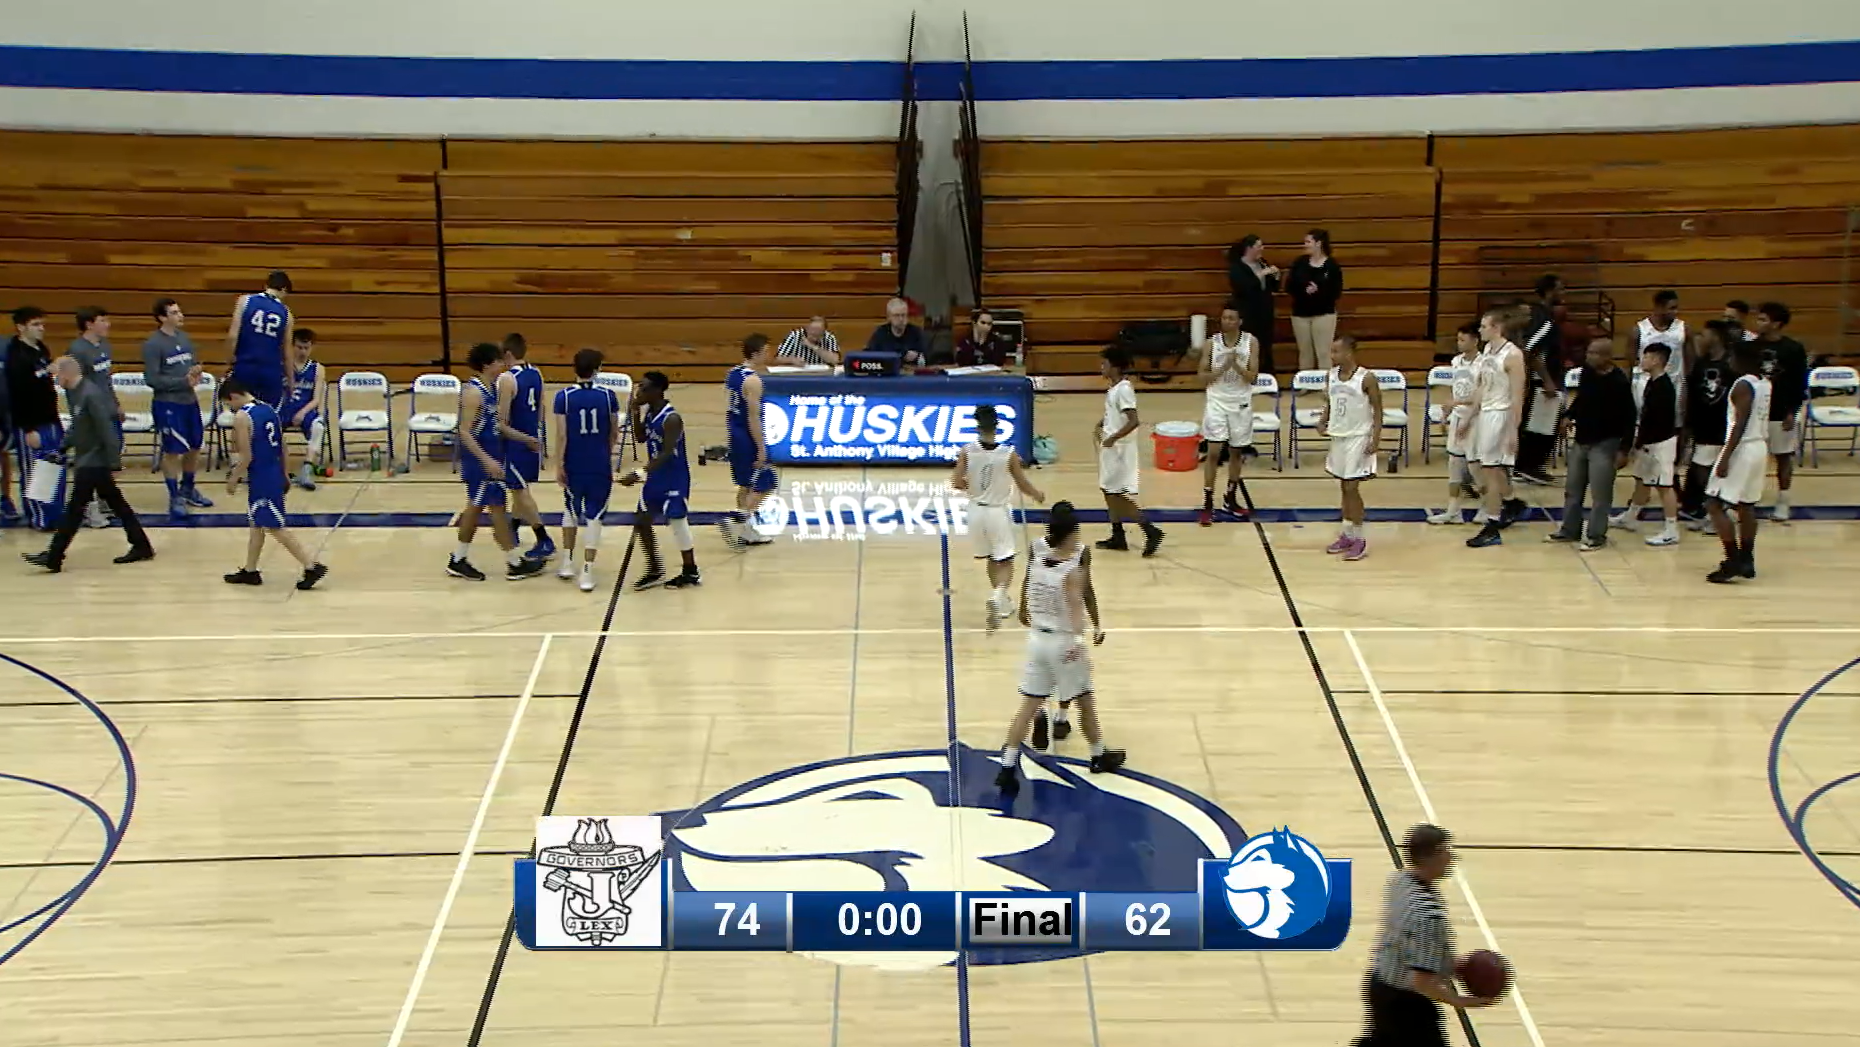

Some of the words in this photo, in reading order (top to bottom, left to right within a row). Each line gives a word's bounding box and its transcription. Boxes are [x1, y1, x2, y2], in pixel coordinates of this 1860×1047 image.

[250, 309, 282, 338] 42
[527, 387, 537, 412] 4
[790, 395, 827, 406] Home
[828, 395, 844, 406] of
[844, 395, 866, 406] the
[1335, 397, 1348, 417] 5
[579, 408, 600, 434] 11
[790, 404, 1016, 443] HUSKIES
[265, 421, 279, 447] 2
[791, 444, 811, 458] St.
[814, 444, 875, 460] Anthony
[877, 443, 927, 460] Village
